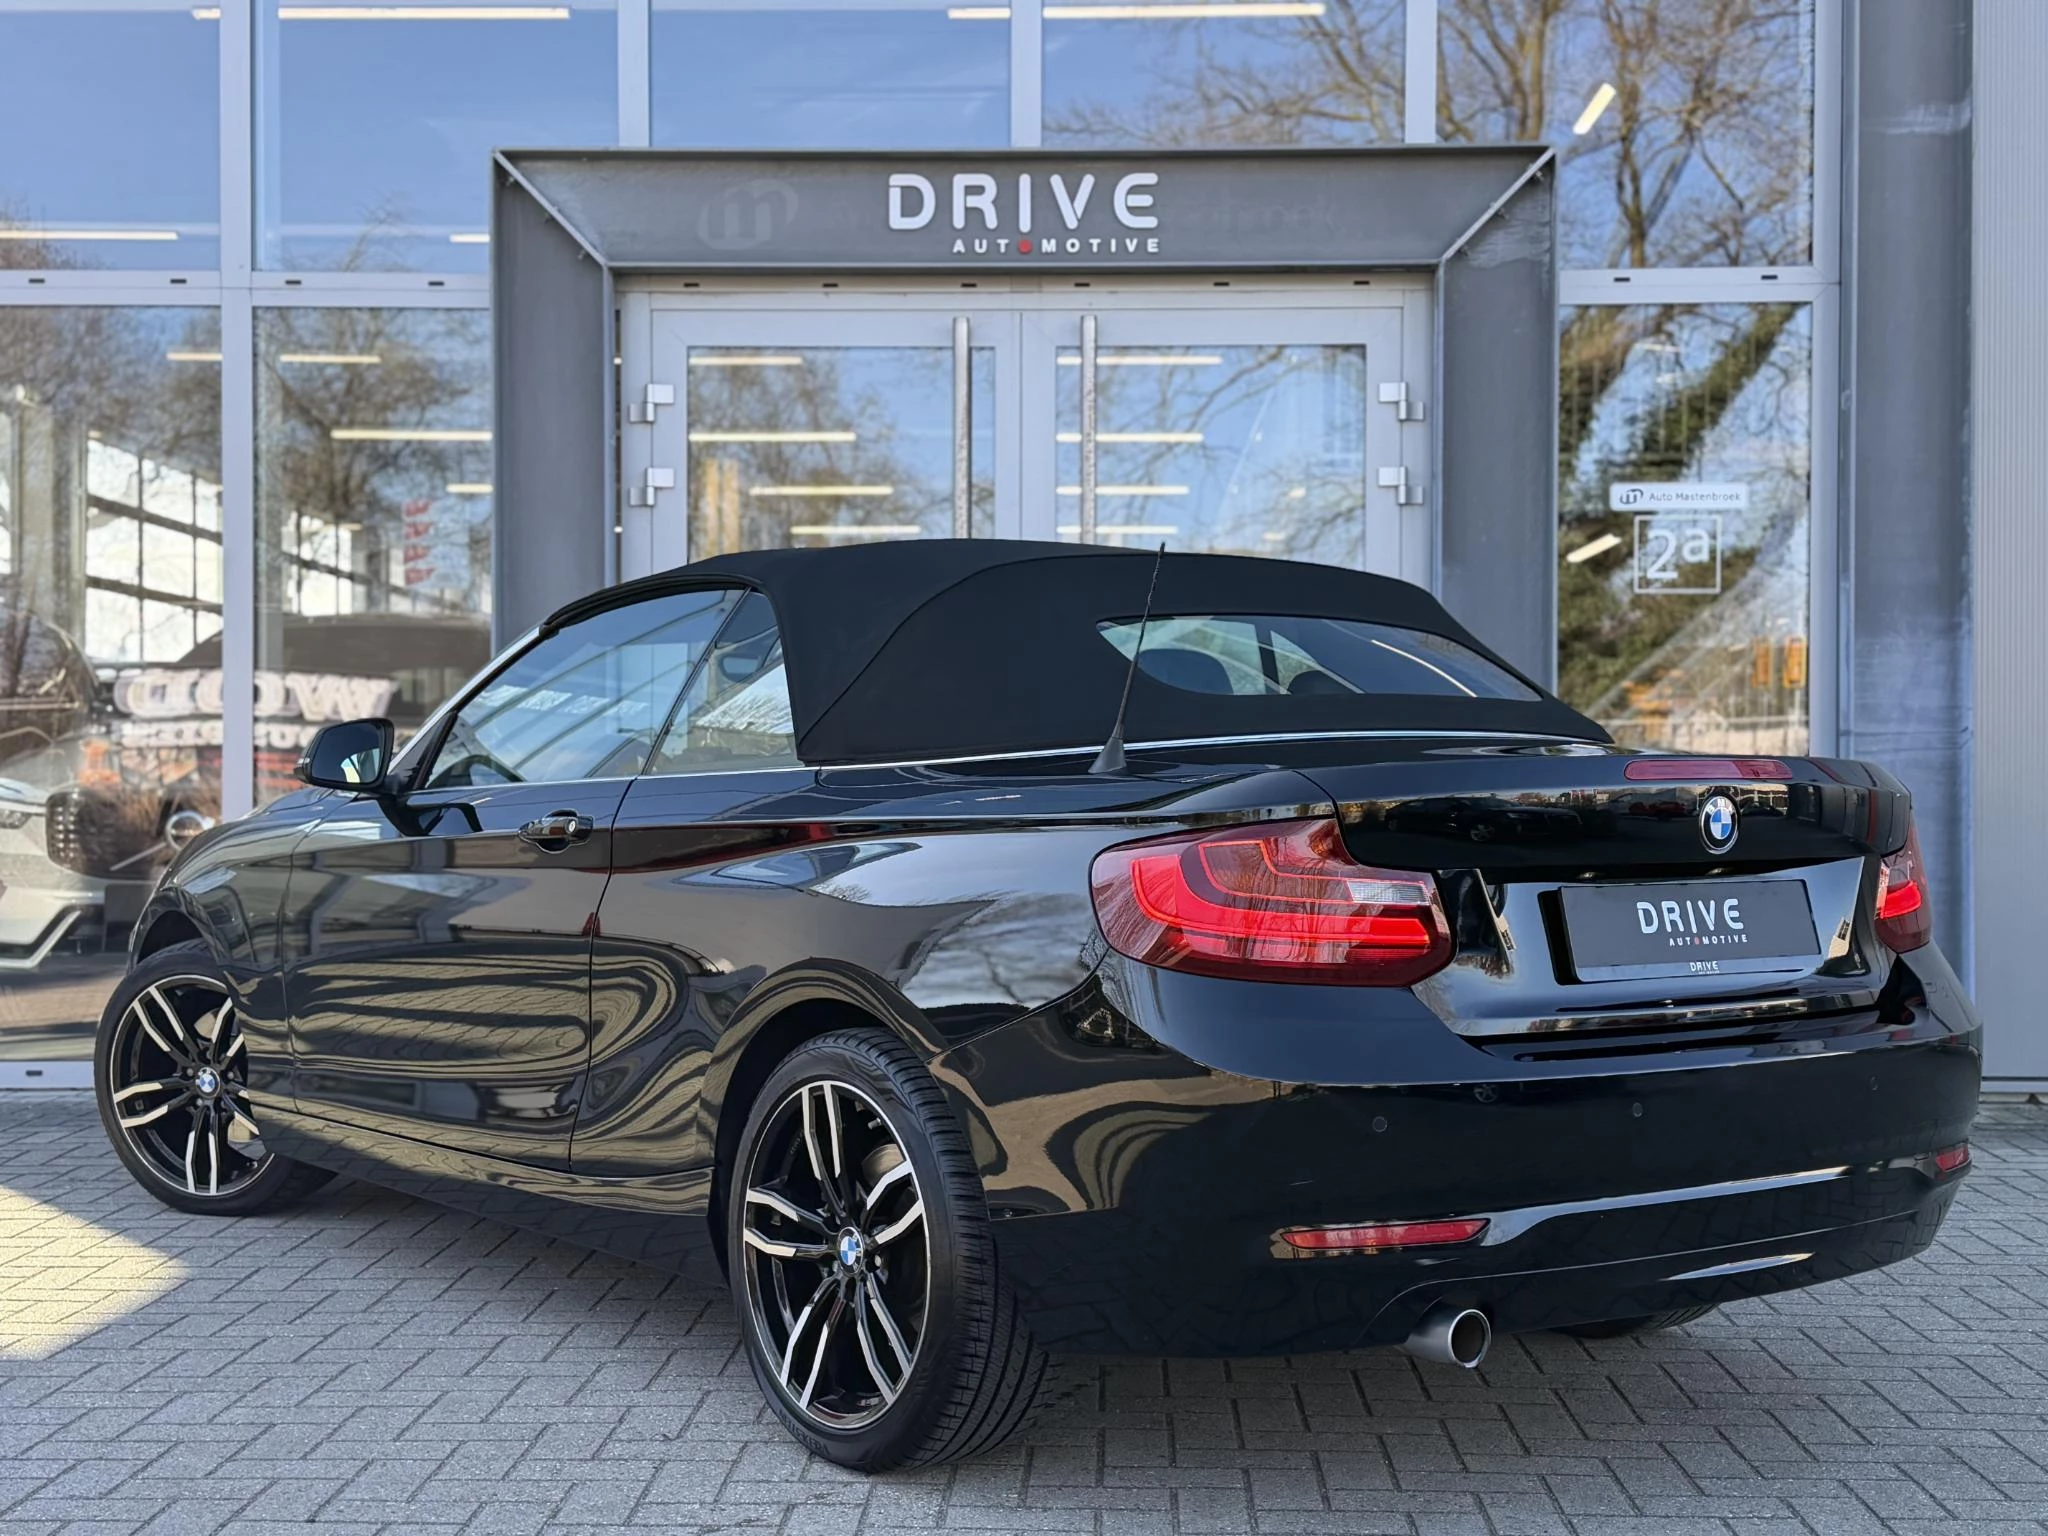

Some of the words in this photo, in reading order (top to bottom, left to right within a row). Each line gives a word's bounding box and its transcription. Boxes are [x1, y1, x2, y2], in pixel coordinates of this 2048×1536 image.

[888, 173, 1159, 233] DRIVE
[1649, 492, 1673, 502] Auto
[1675, 492, 1741, 502] Mastenbroek
[1646, 527, 1711, 580] 2a
[1636, 898, 1744, 934] DRIVE
[1688, 960, 1719, 973] DRIVE
